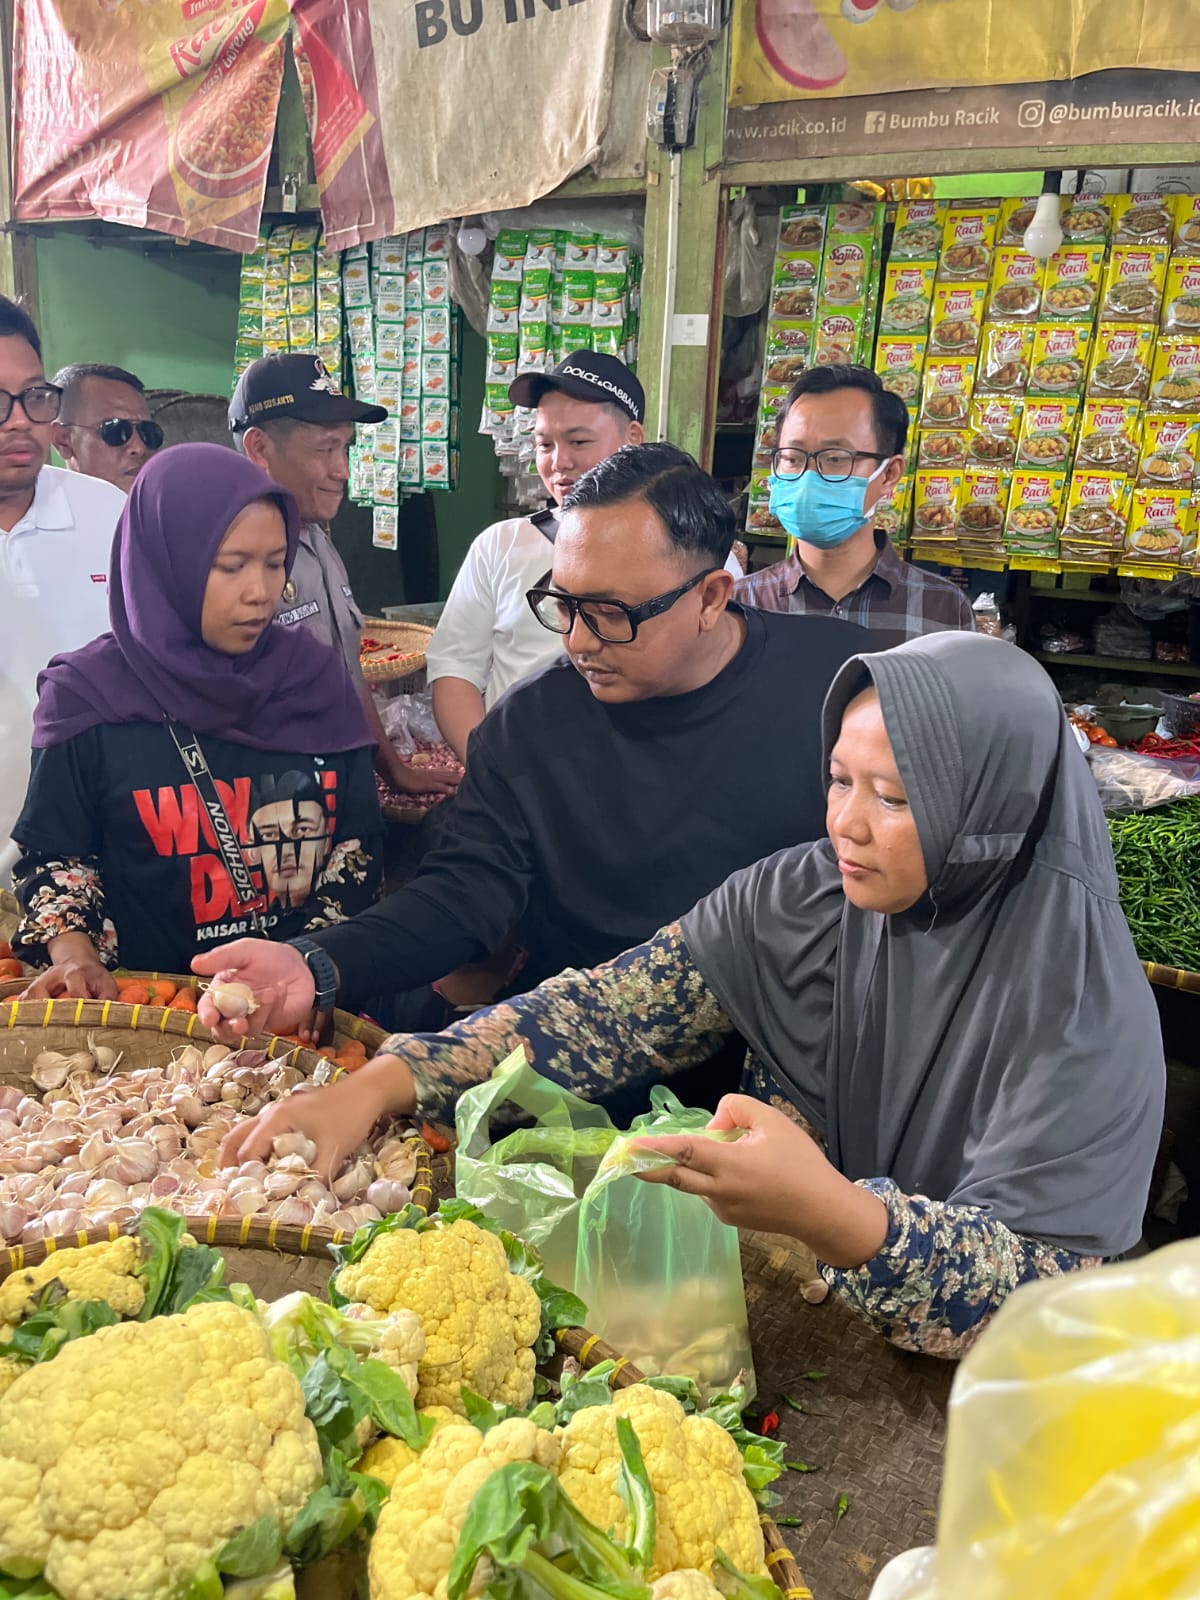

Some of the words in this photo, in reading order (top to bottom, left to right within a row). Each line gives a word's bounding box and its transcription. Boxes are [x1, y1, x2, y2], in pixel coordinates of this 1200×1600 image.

[415, 0, 483, 48] BU
[890, 111, 949, 129] Bumbu
[955, 107, 1000, 126] Racik
[906, 204, 936, 220] Racik
[954, 223, 984, 237] Racik
[829, 248, 864, 265] Sajiku
[1006, 263, 1037, 277] Racik
[1057, 261, 1089, 276] Racik
[1119, 260, 1153, 276] Racik
[894, 277, 923, 291] Racik
[944, 298, 973, 312] Racik
[1044, 337, 1077, 352] Racik
[1106, 337, 1139, 352] Racik
[885, 350, 914, 364] Racik
[935, 370, 963, 386] Racik
[1092, 412, 1126, 427] Racik
[924, 483, 953, 497] Racik
[970, 483, 999, 496] Racik
[1021, 484, 1052, 498] Racik
[1080, 483, 1111, 497] Racik
[1144, 504, 1177, 519] Racik
[196, 920, 247, 941] KAISAR
